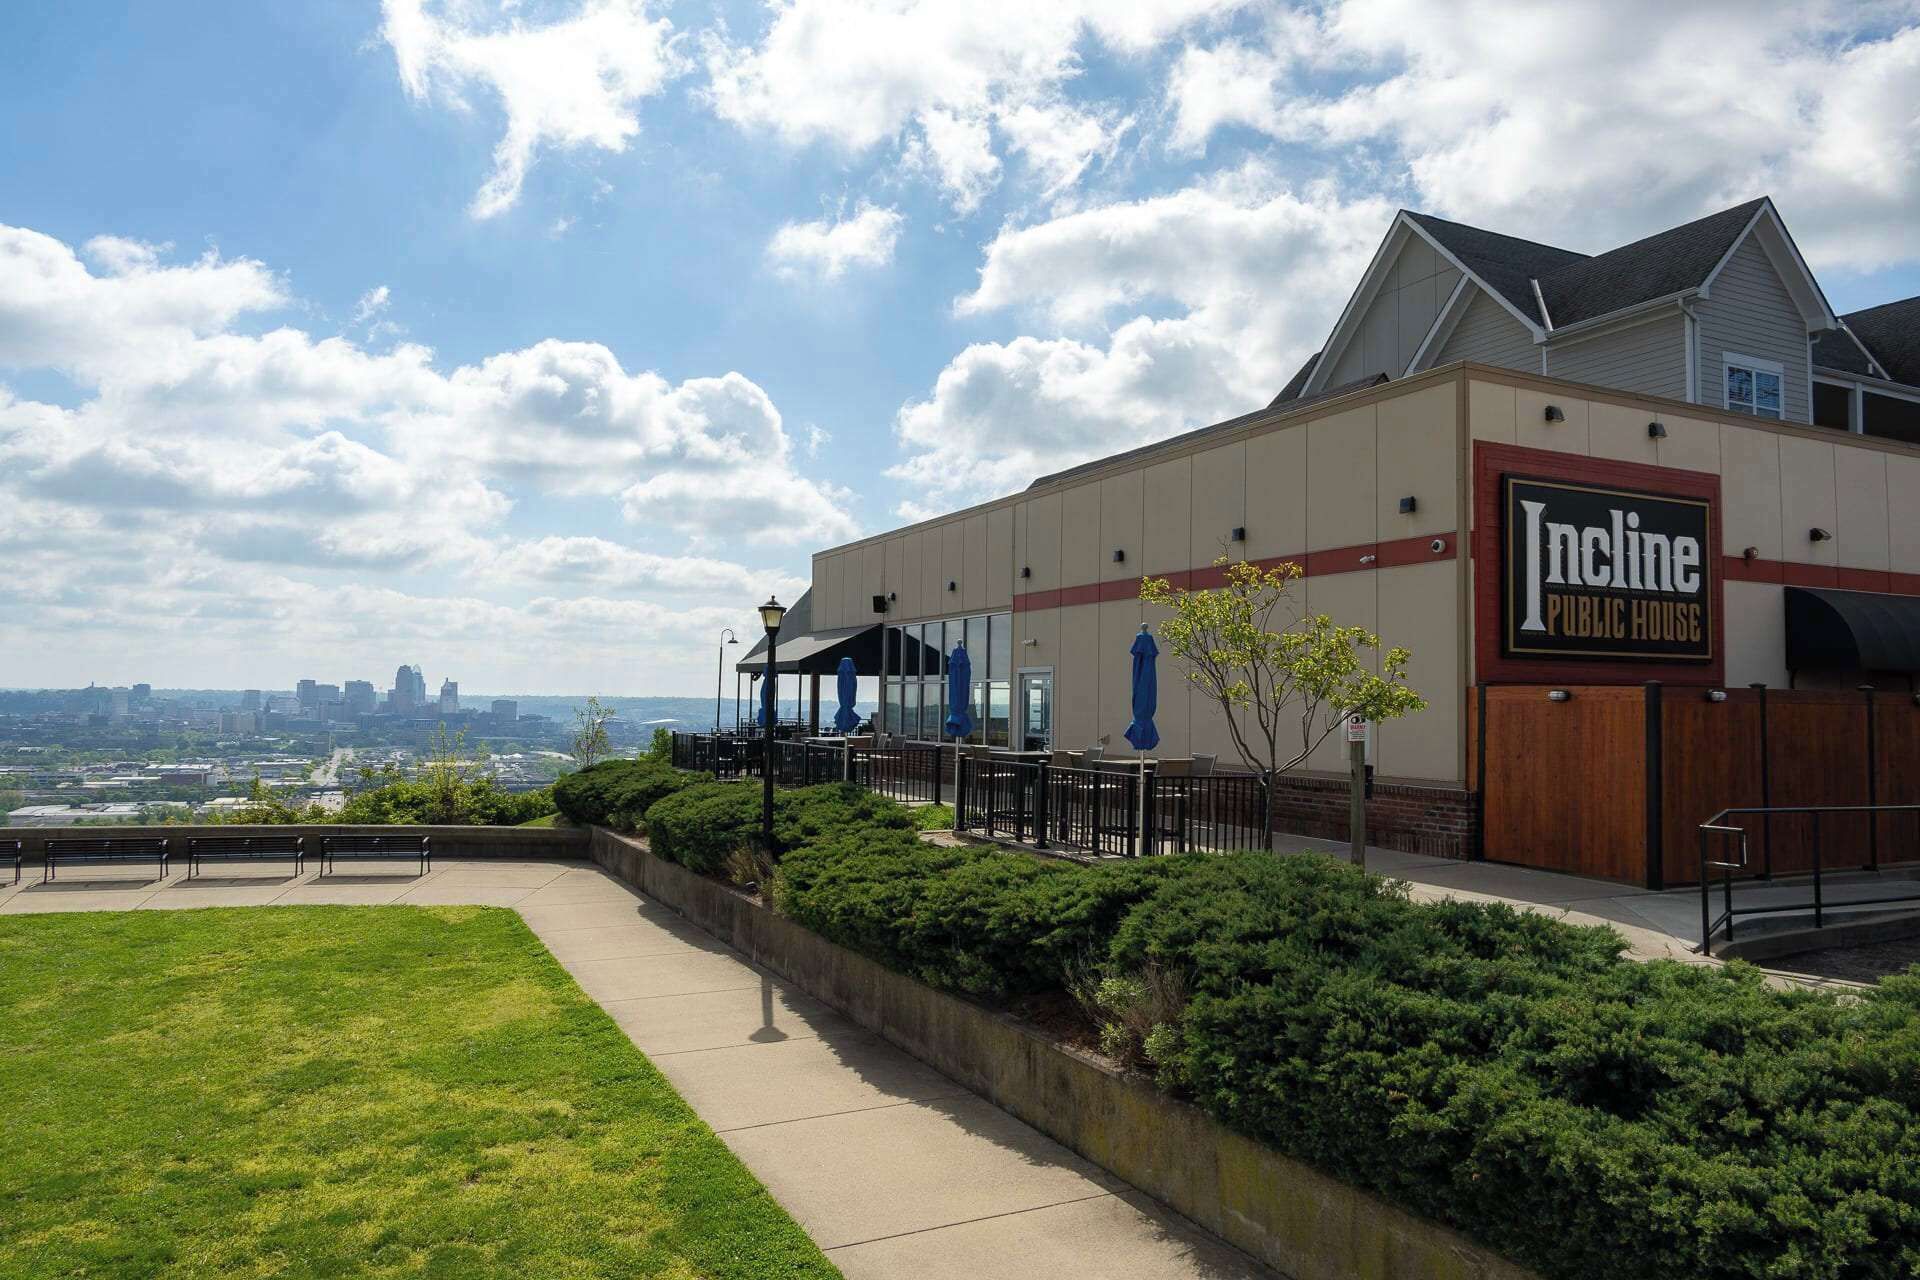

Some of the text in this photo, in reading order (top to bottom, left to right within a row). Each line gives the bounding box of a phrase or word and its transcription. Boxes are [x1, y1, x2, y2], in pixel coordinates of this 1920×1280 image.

[1520, 501, 1700, 631] Incline
[1547, 594, 1700, 642] PUBLIC HOUSE
